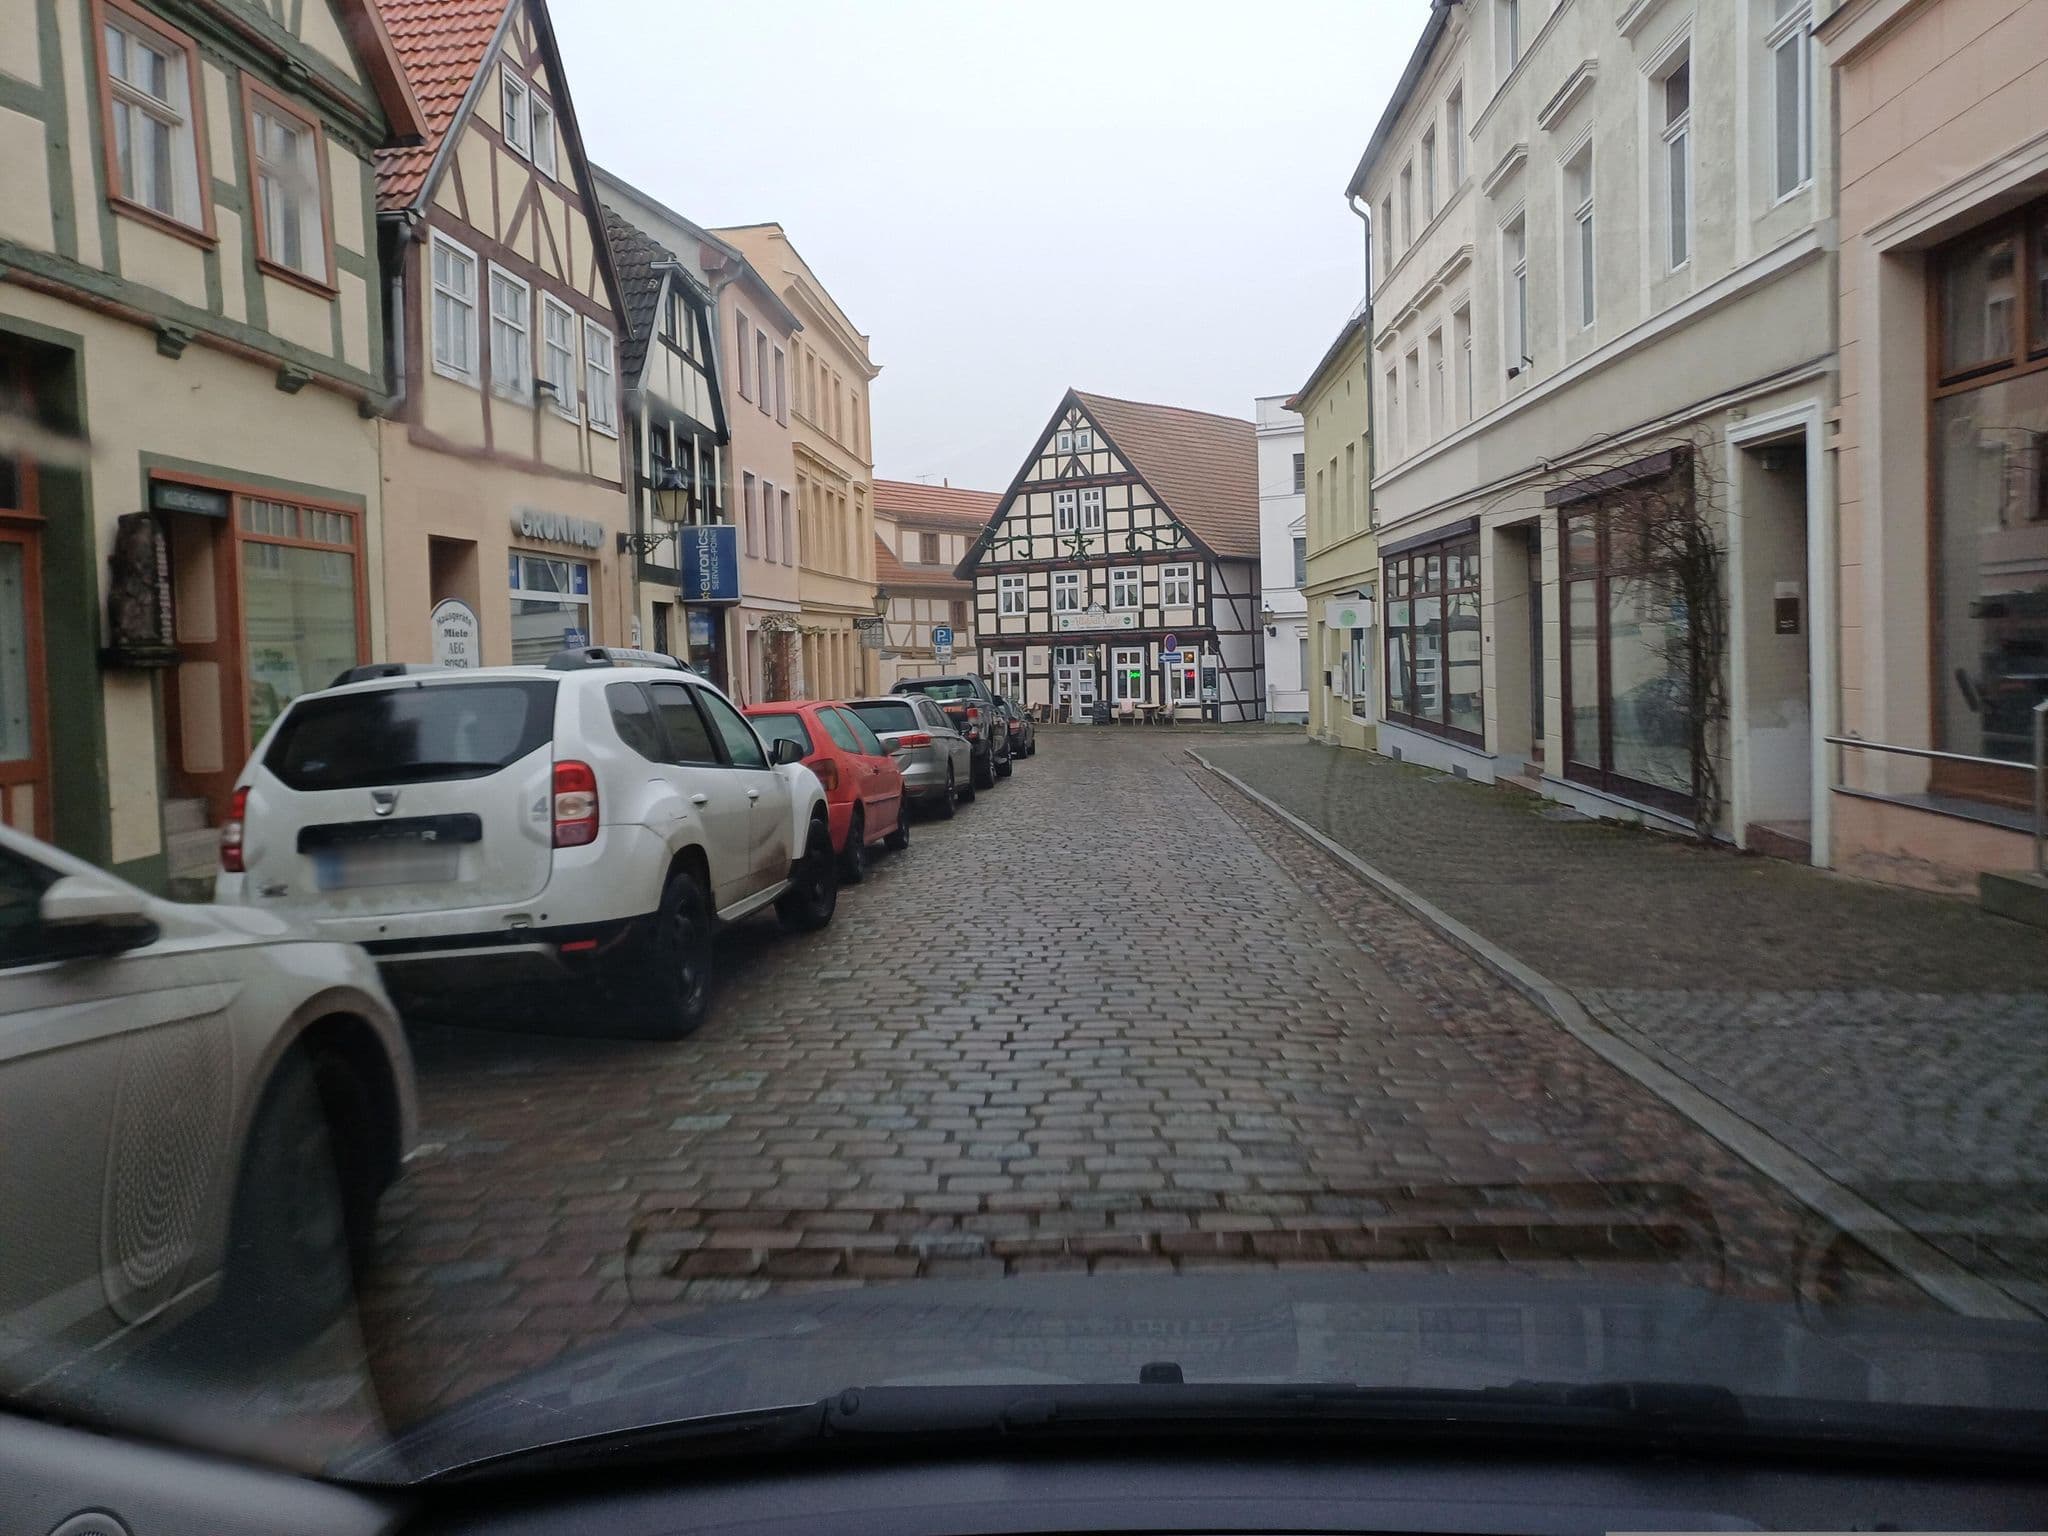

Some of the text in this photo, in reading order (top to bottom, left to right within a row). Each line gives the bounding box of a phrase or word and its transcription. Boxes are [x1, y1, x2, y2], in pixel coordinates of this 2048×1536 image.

[696, 528, 710, 591] euronics
[443, 628, 468, 638] Miele
[936, 629, 946, 642] P
[448, 641, 465, 655] AEG
